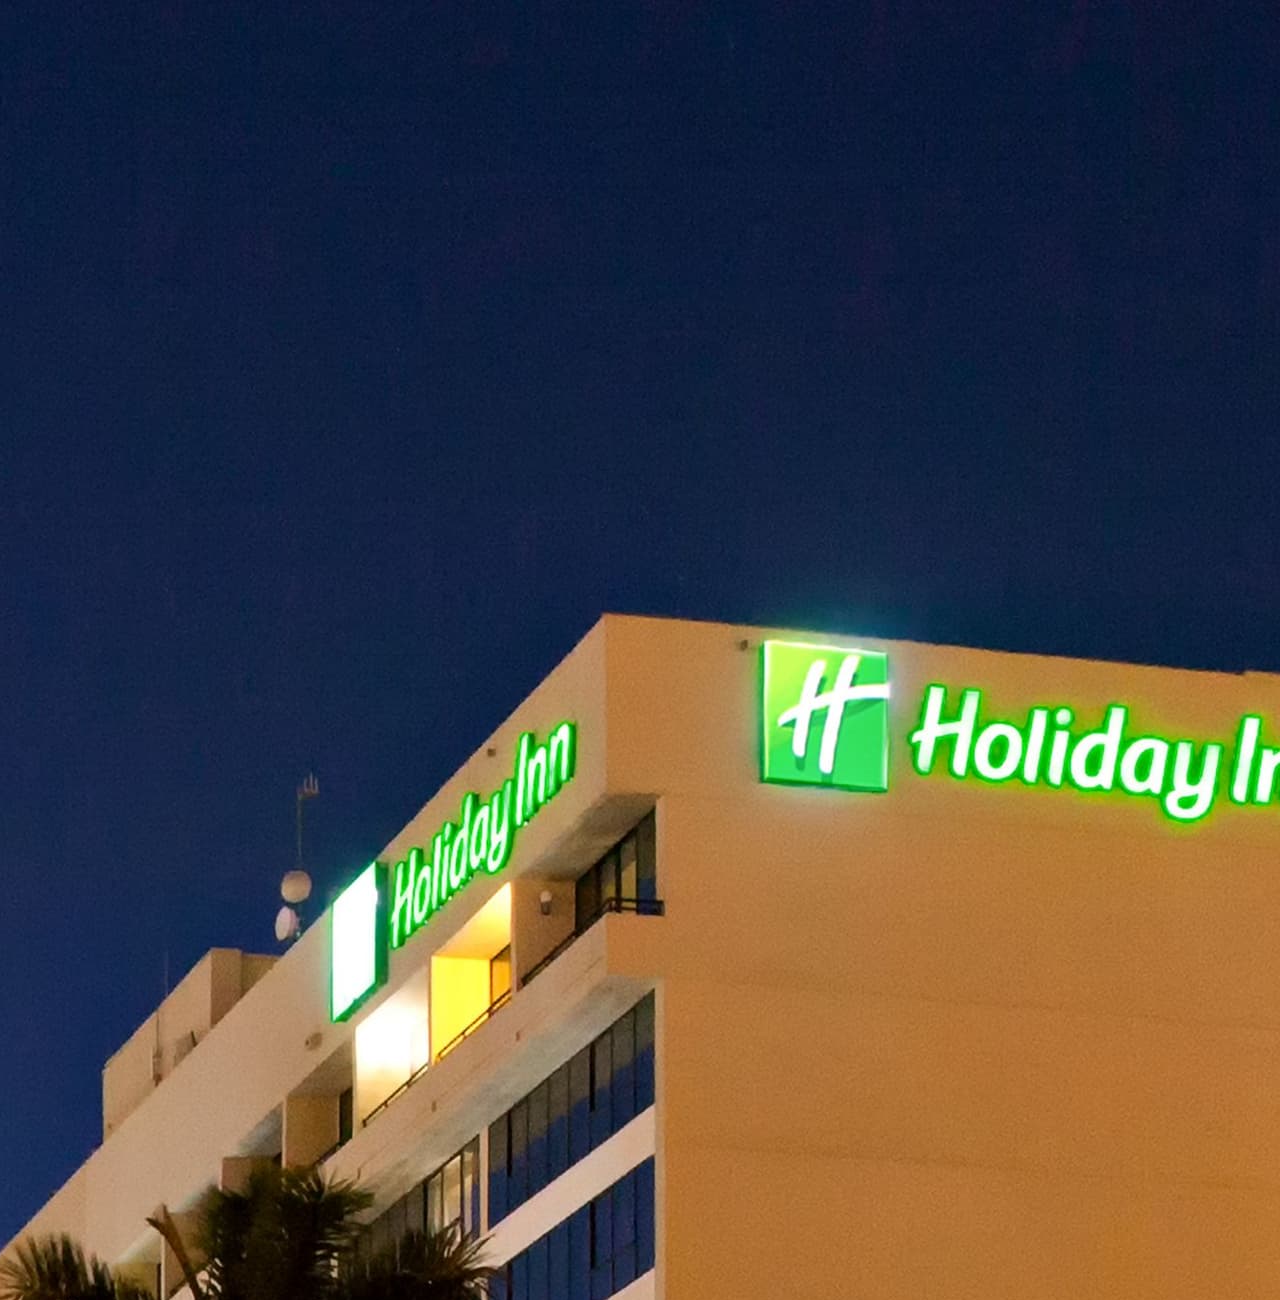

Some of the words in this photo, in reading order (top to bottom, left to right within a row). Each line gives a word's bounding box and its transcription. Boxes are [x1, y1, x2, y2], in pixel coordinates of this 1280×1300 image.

[777, 655, 891, 774] H
[911, 685, 1219, 819] Holiday
[390, 779, 513, 949] Holiday
[515, 722, 572, 826] Inn
